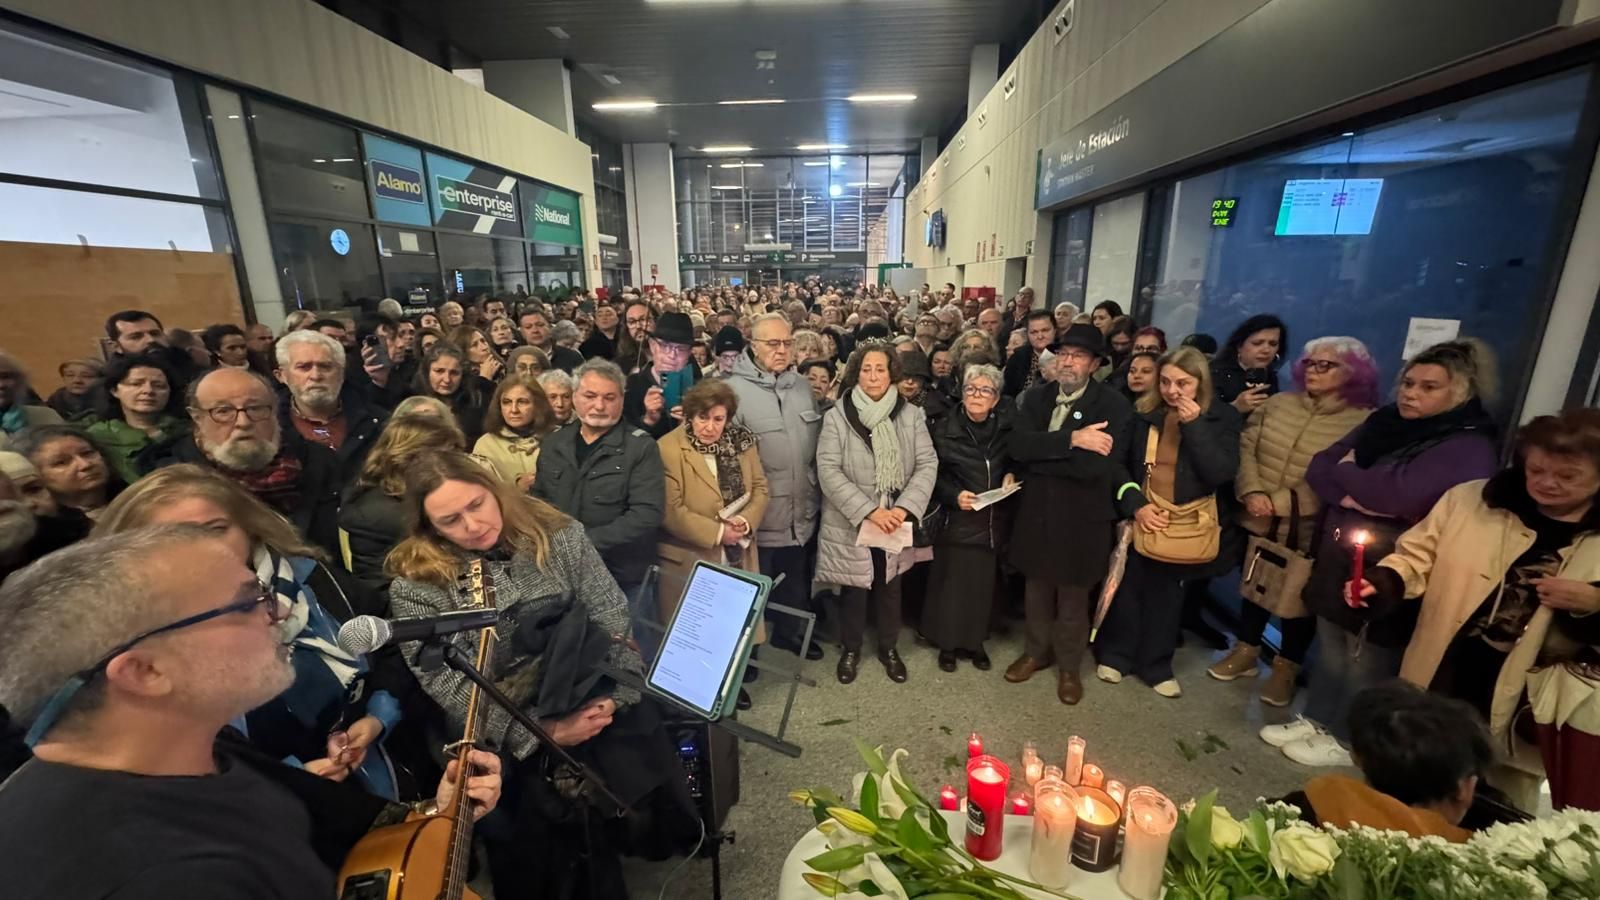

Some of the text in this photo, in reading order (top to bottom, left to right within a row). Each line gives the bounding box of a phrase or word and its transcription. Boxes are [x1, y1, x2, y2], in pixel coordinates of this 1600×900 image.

[1088, 115, 1130, 155] Estación
[377, 171, 421, 195] Alamo
[440, 184, 514, 213] enterprise
[543, 207, 571, 226] National
